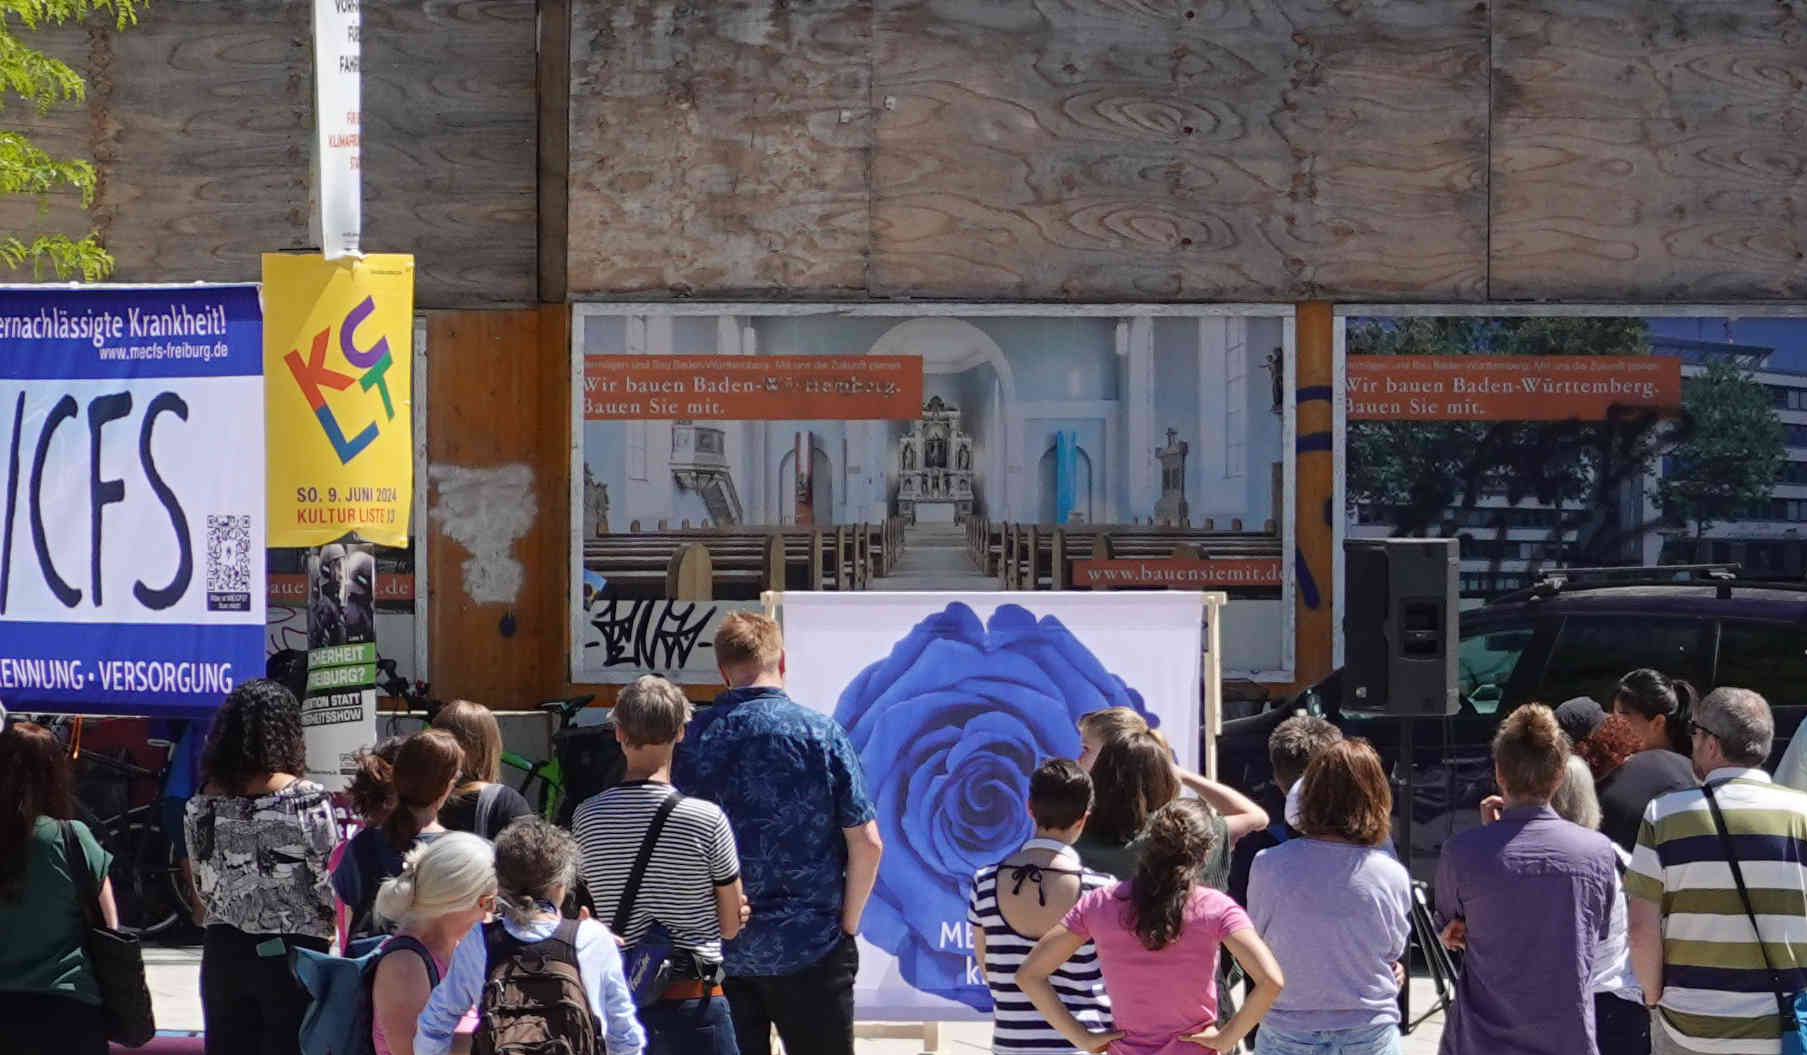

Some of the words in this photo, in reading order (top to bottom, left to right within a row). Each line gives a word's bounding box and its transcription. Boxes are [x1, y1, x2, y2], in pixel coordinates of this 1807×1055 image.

[128, 305, 227, 338] Krankheit!
[99, 342, 229, 361] www.mecfs-freiburg.de
[626, 376, 684, 392] bauen
[1385, 376, 1444, 392] bauen
[1453, 376, 1659, 398] Baden-Württemberg.
[649, 399, 677, 414] Sie
[687, 398, 725, 414] mit.
[1408, 399, 1437, 414] Sie
[1447, 399, 1486, 414] mit.
[296, 486, 322, 503] SO.
[328, 487, 342, 503] 9.
[345, 487, 373, 503] JUNI
[296, 508, 355, 524] KULTUR
[360, 507, 385, 523] LISTE
[99, 660, 233, 694] VERSORGUNG
[940, 920, 976, 949] ME
[966, 955, 986, 986] k
